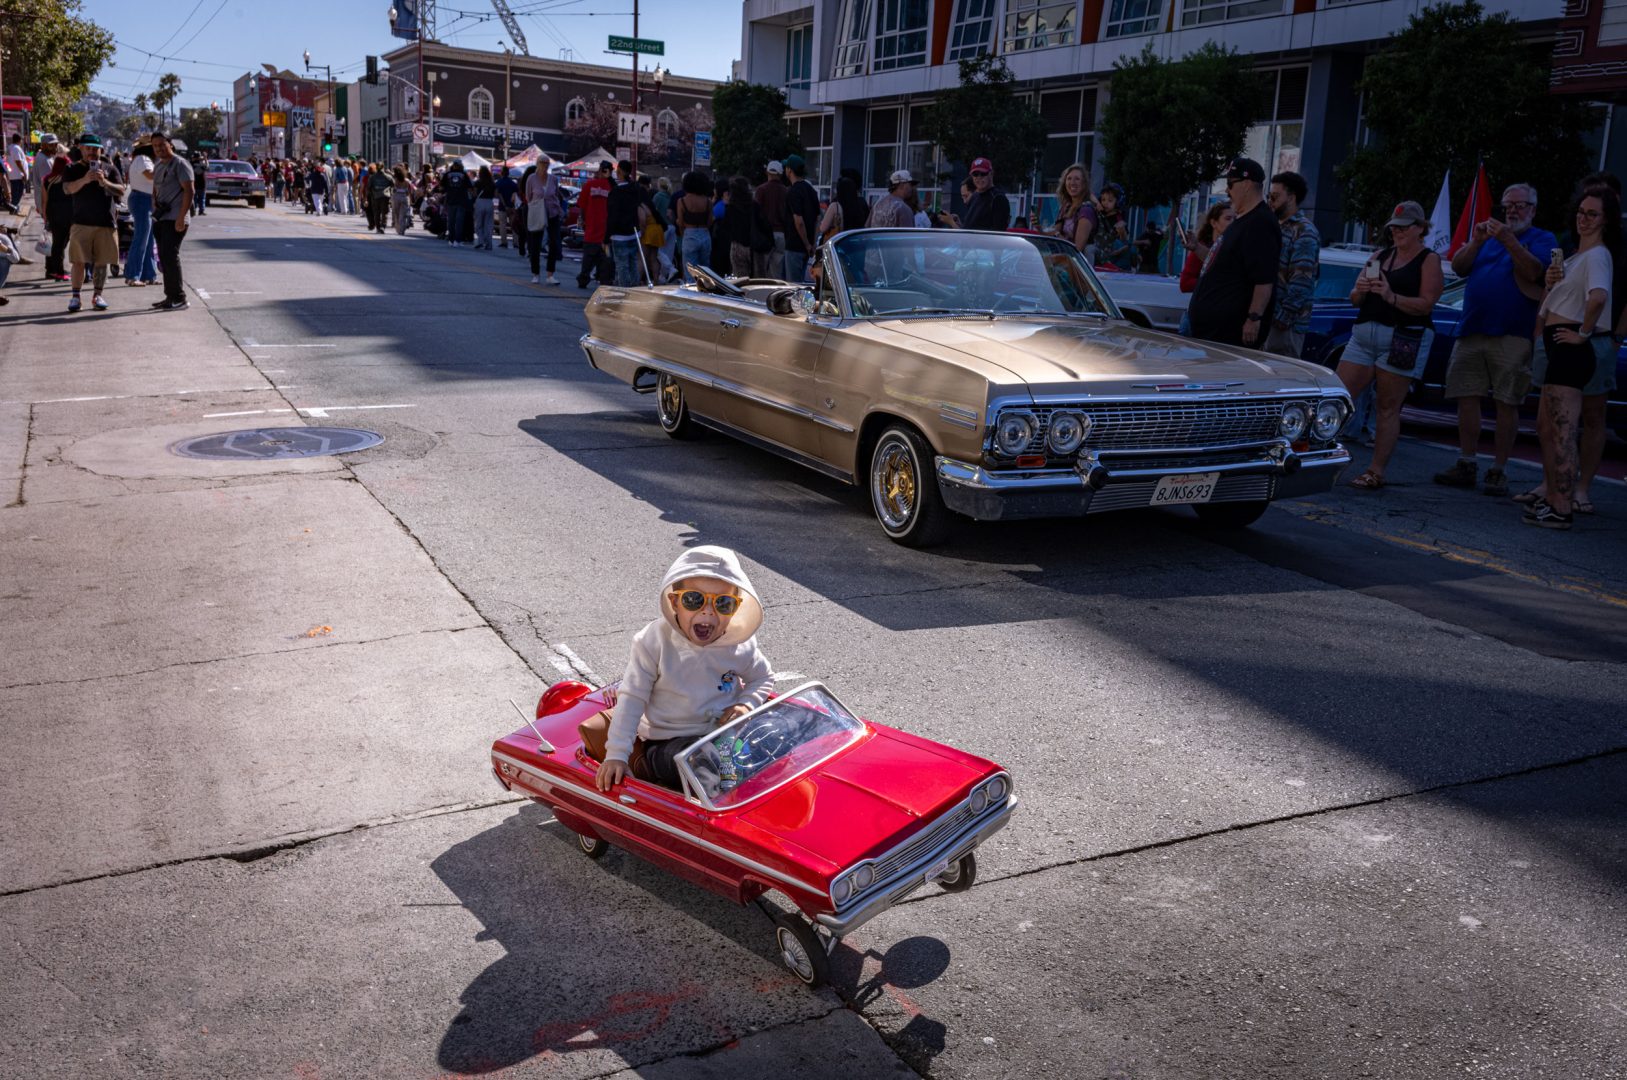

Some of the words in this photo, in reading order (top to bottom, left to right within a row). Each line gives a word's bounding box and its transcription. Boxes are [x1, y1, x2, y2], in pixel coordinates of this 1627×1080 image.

[611, 39, 634, 49] 22nd
[635, 41, 660, 51] Street
[464, 124, 530, 141] SKECHERS
[1156, 484, 1212, 501] 8JNS693
